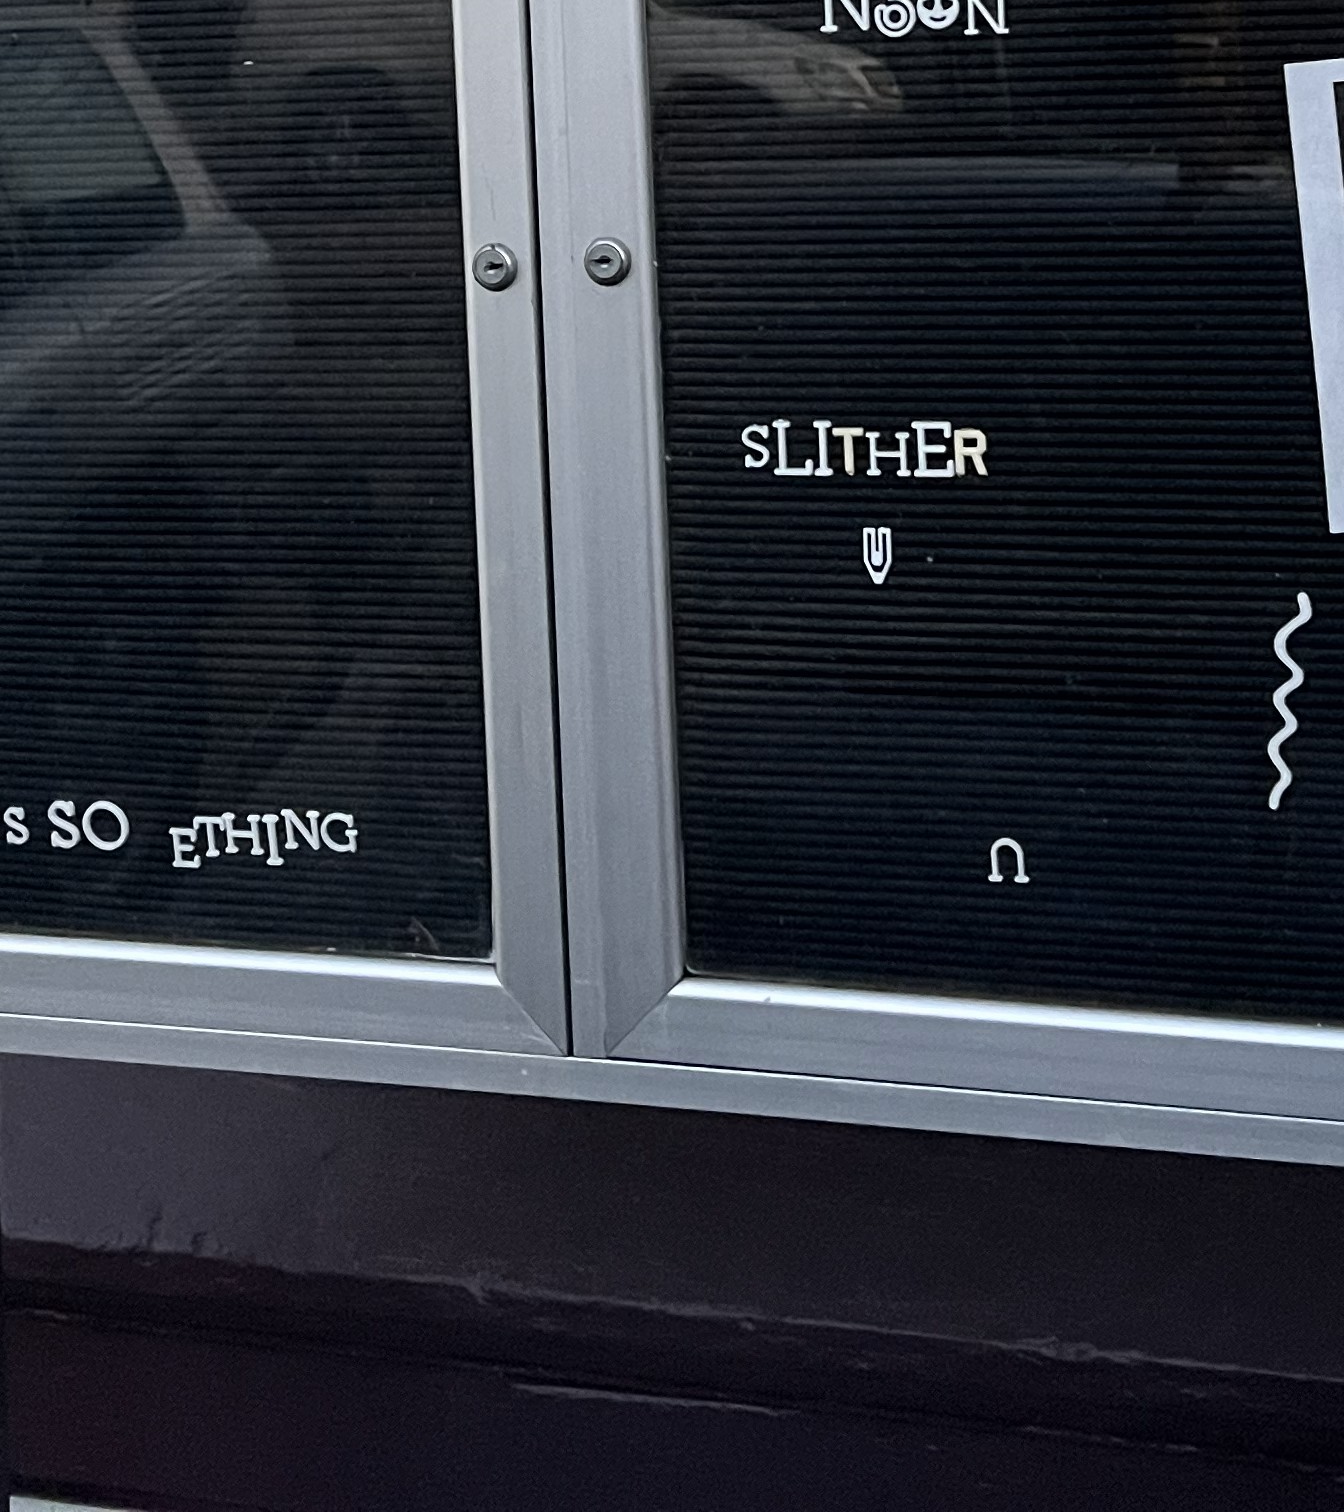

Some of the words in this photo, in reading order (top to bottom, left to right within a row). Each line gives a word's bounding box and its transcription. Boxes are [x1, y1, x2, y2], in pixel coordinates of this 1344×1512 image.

[740, 419, 989, 477] SLITHER
[48, 801, 130, 852] SO
[170, 809, 358, 869] ETHING
